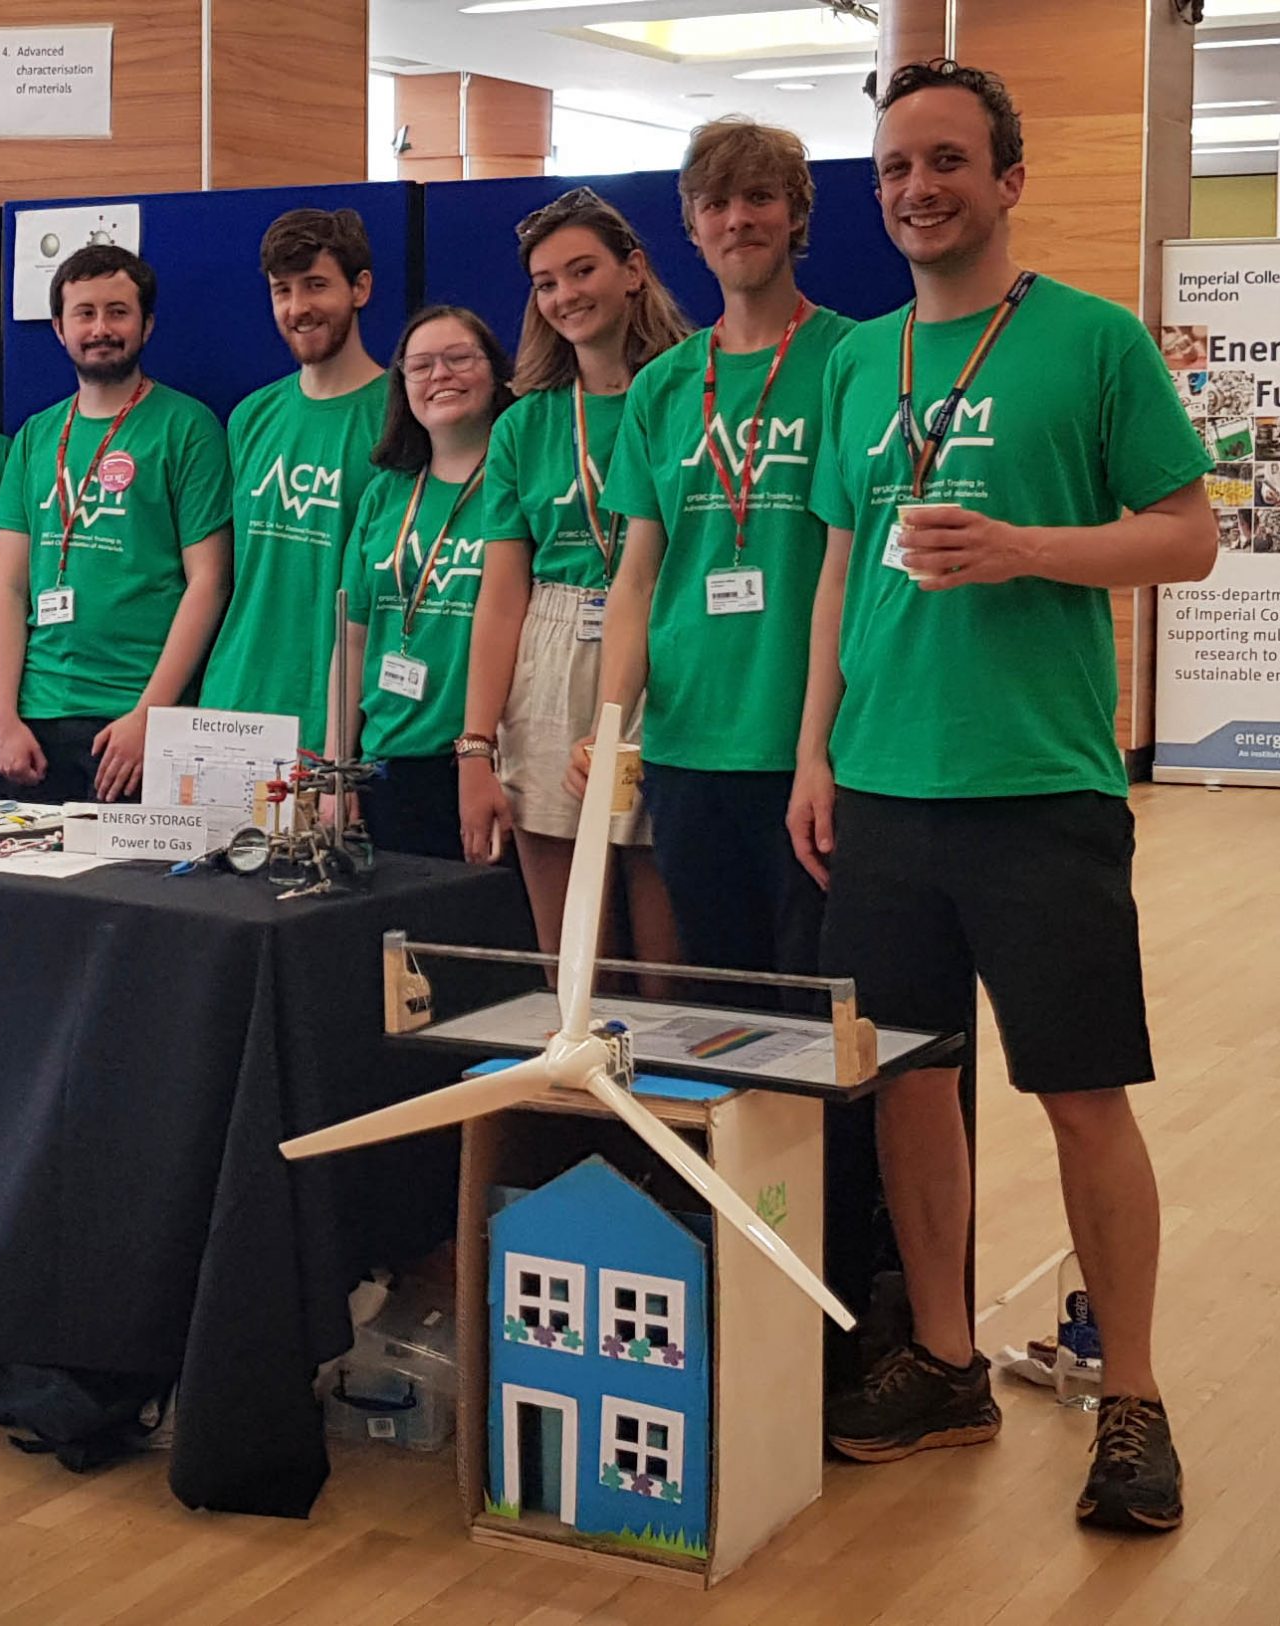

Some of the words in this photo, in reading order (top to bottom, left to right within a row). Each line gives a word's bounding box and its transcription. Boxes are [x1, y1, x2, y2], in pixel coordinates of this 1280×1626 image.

[2, 46, 11, 57] 4.
[17, 46, 65, 57] Advanced
[16, 64, 93, 76] characterisation
[16, 83, 26, 94] of
[28, 83, 72, 94] materials
[1179, 271, 1240, 288] Imperial
[1179, 289, 1239, 302] London
[681, 412, 809, 485] ACM
[251, 453, 341, 520] ACM
[1163, 587, 1173, 599] A
[1176, 607, 1192, 620] of
[1195, 608, 1256, 623] Imperial
[1168, 628, 1249, 644] supporting
[1195, 648, 1258, 661] research
[1263, 650, 1278, 661] to
[1175, 667, 1262, 681] sustainable
[192, 718, 264, 736] Electrolyser
[102, 812, 146, 825] ENERGY
[149, 814, 202, 827] STORAGE
[111, 835, 149, 849] Power
[153, 837, 166, 849] to
[169, 838, 192, 850] Gas
